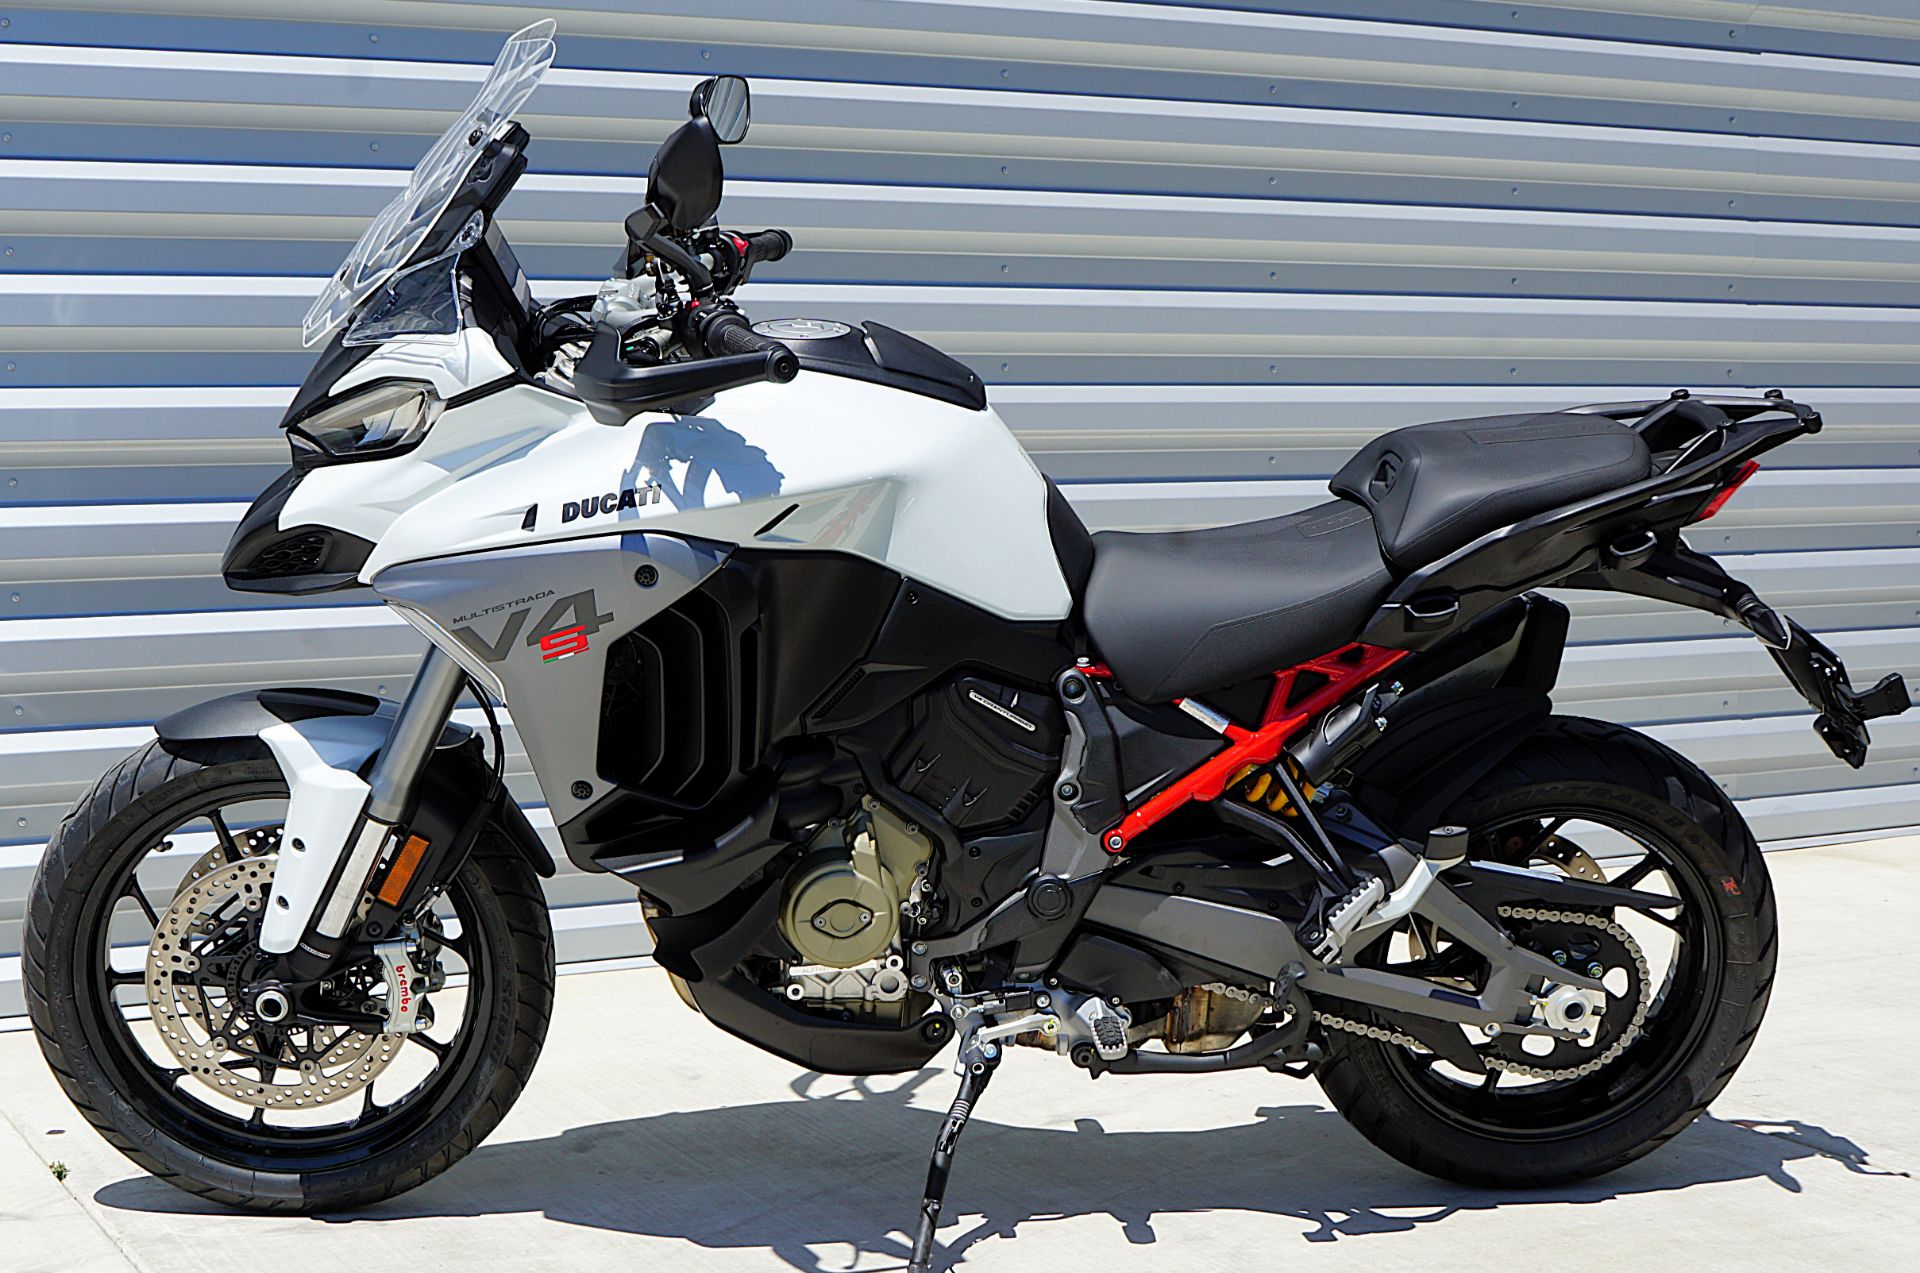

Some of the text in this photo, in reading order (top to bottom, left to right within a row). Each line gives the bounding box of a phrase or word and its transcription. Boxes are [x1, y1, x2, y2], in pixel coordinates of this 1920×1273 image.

[561, 484, 662, 524] DUCATI
[451, 588, 615, 663] V4
[452, 589, 556, 625] MULTISTRADA
[395, 964, 412, 1013] brembo
